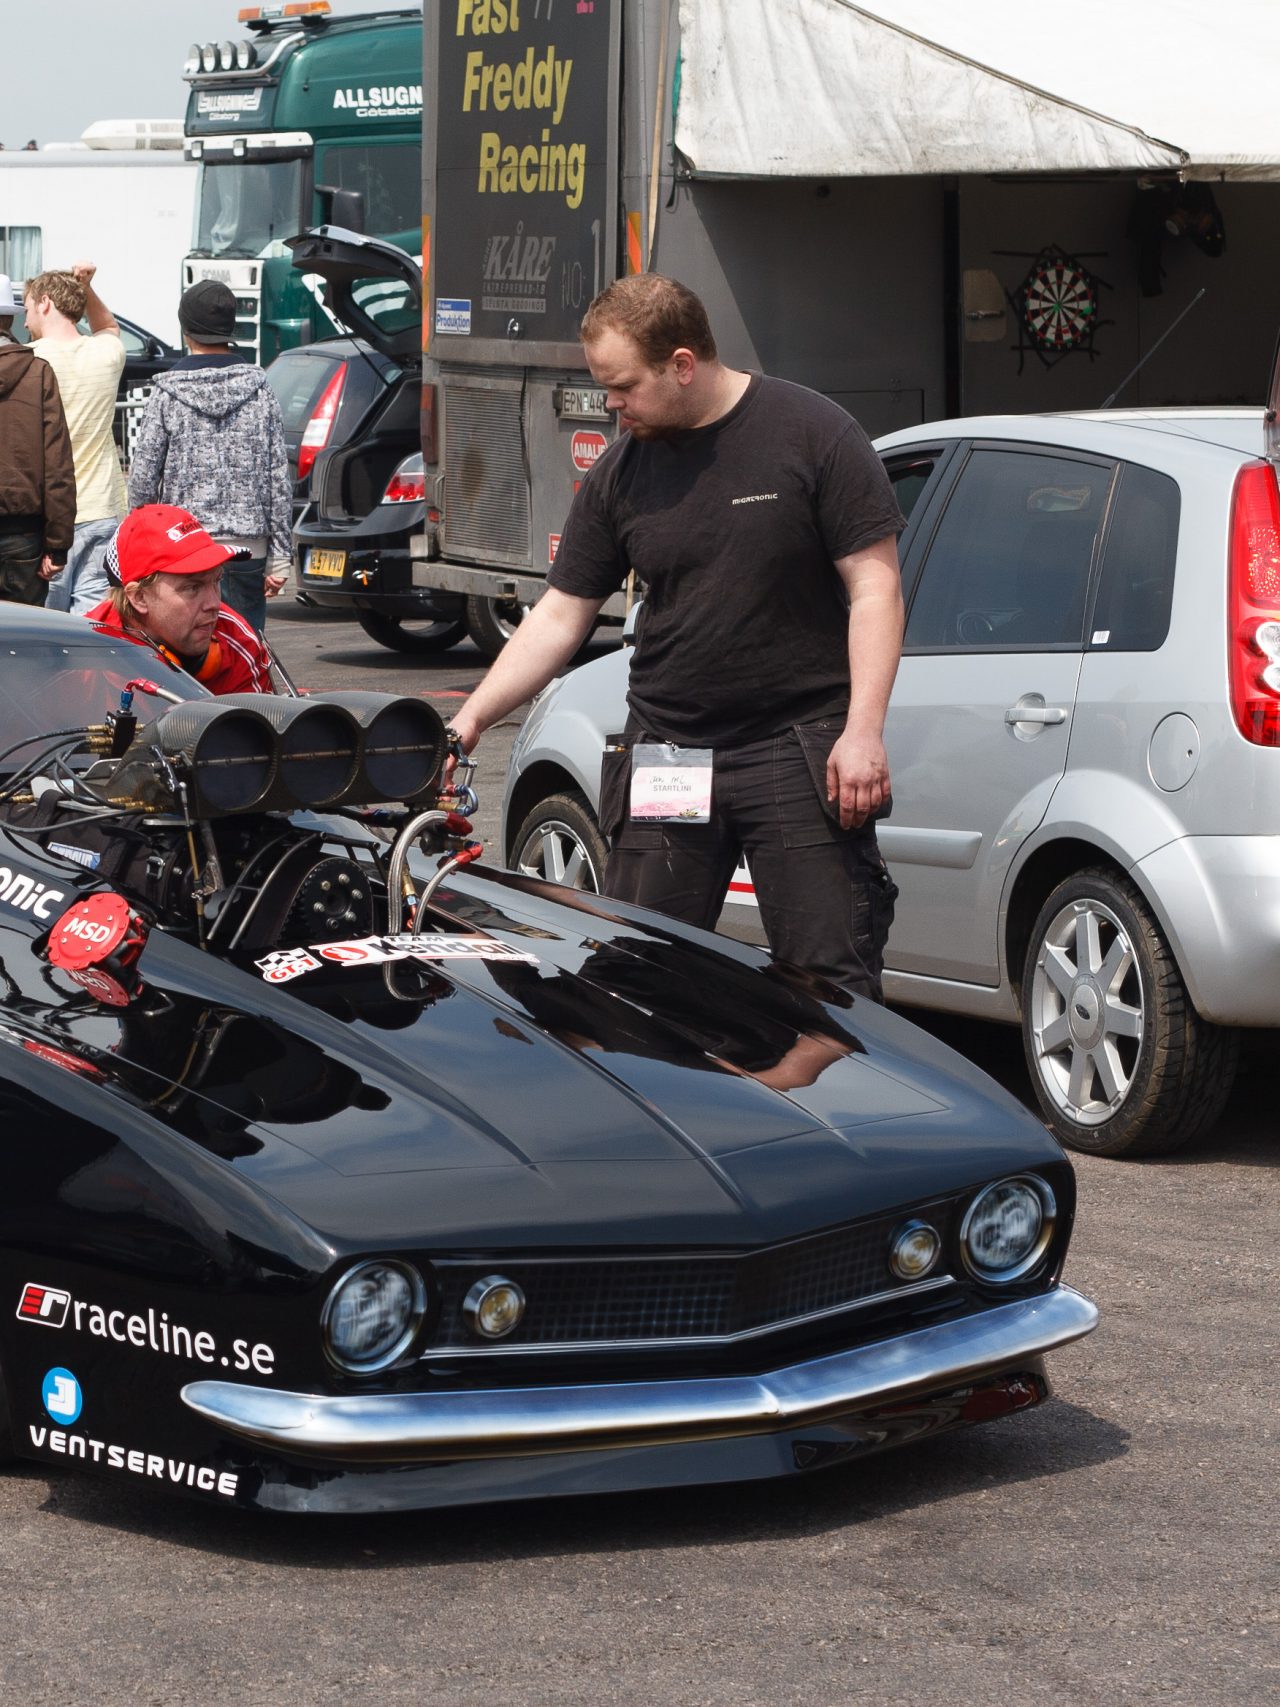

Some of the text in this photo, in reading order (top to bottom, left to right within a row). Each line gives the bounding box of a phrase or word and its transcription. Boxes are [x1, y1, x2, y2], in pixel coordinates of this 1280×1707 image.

[456, 0, 519, 36] Fast
[333, 85, 423, 108] ALLSUGN
[463, 45, 573, 126] Freddy
[478, 129, 587, 209] Racing
[483, 220, 557, 281] KÅRE
[436, 313, 470, 332] Produktion
[563, 392, 583, 413] EPN
[63, 917, 111, 943] MSD
[74, 1299, 275, 1375] raceline.se
[29, 1424, 239, 1497] VENTSERVICE
